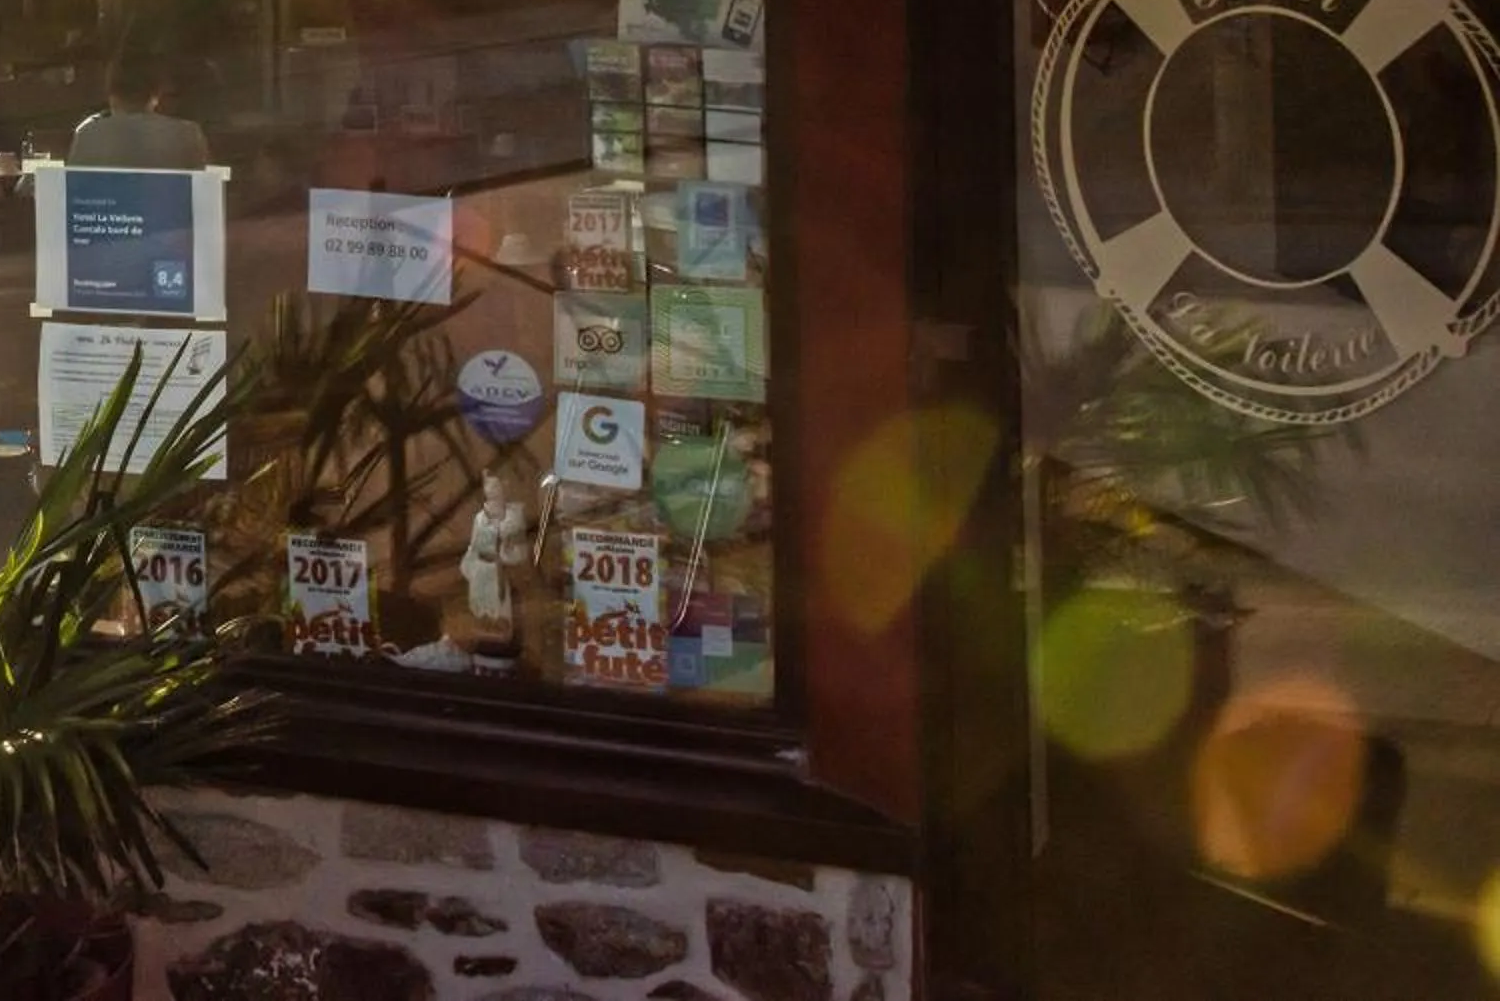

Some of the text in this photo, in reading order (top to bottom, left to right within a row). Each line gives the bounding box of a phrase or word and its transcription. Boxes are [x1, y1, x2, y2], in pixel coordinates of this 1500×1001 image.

[582, 405, 619, 445] G
[134, 553, 204, 587] 2016
[294, 555, 364, 589] 2017
[578, 552, 654, 588] 2018
